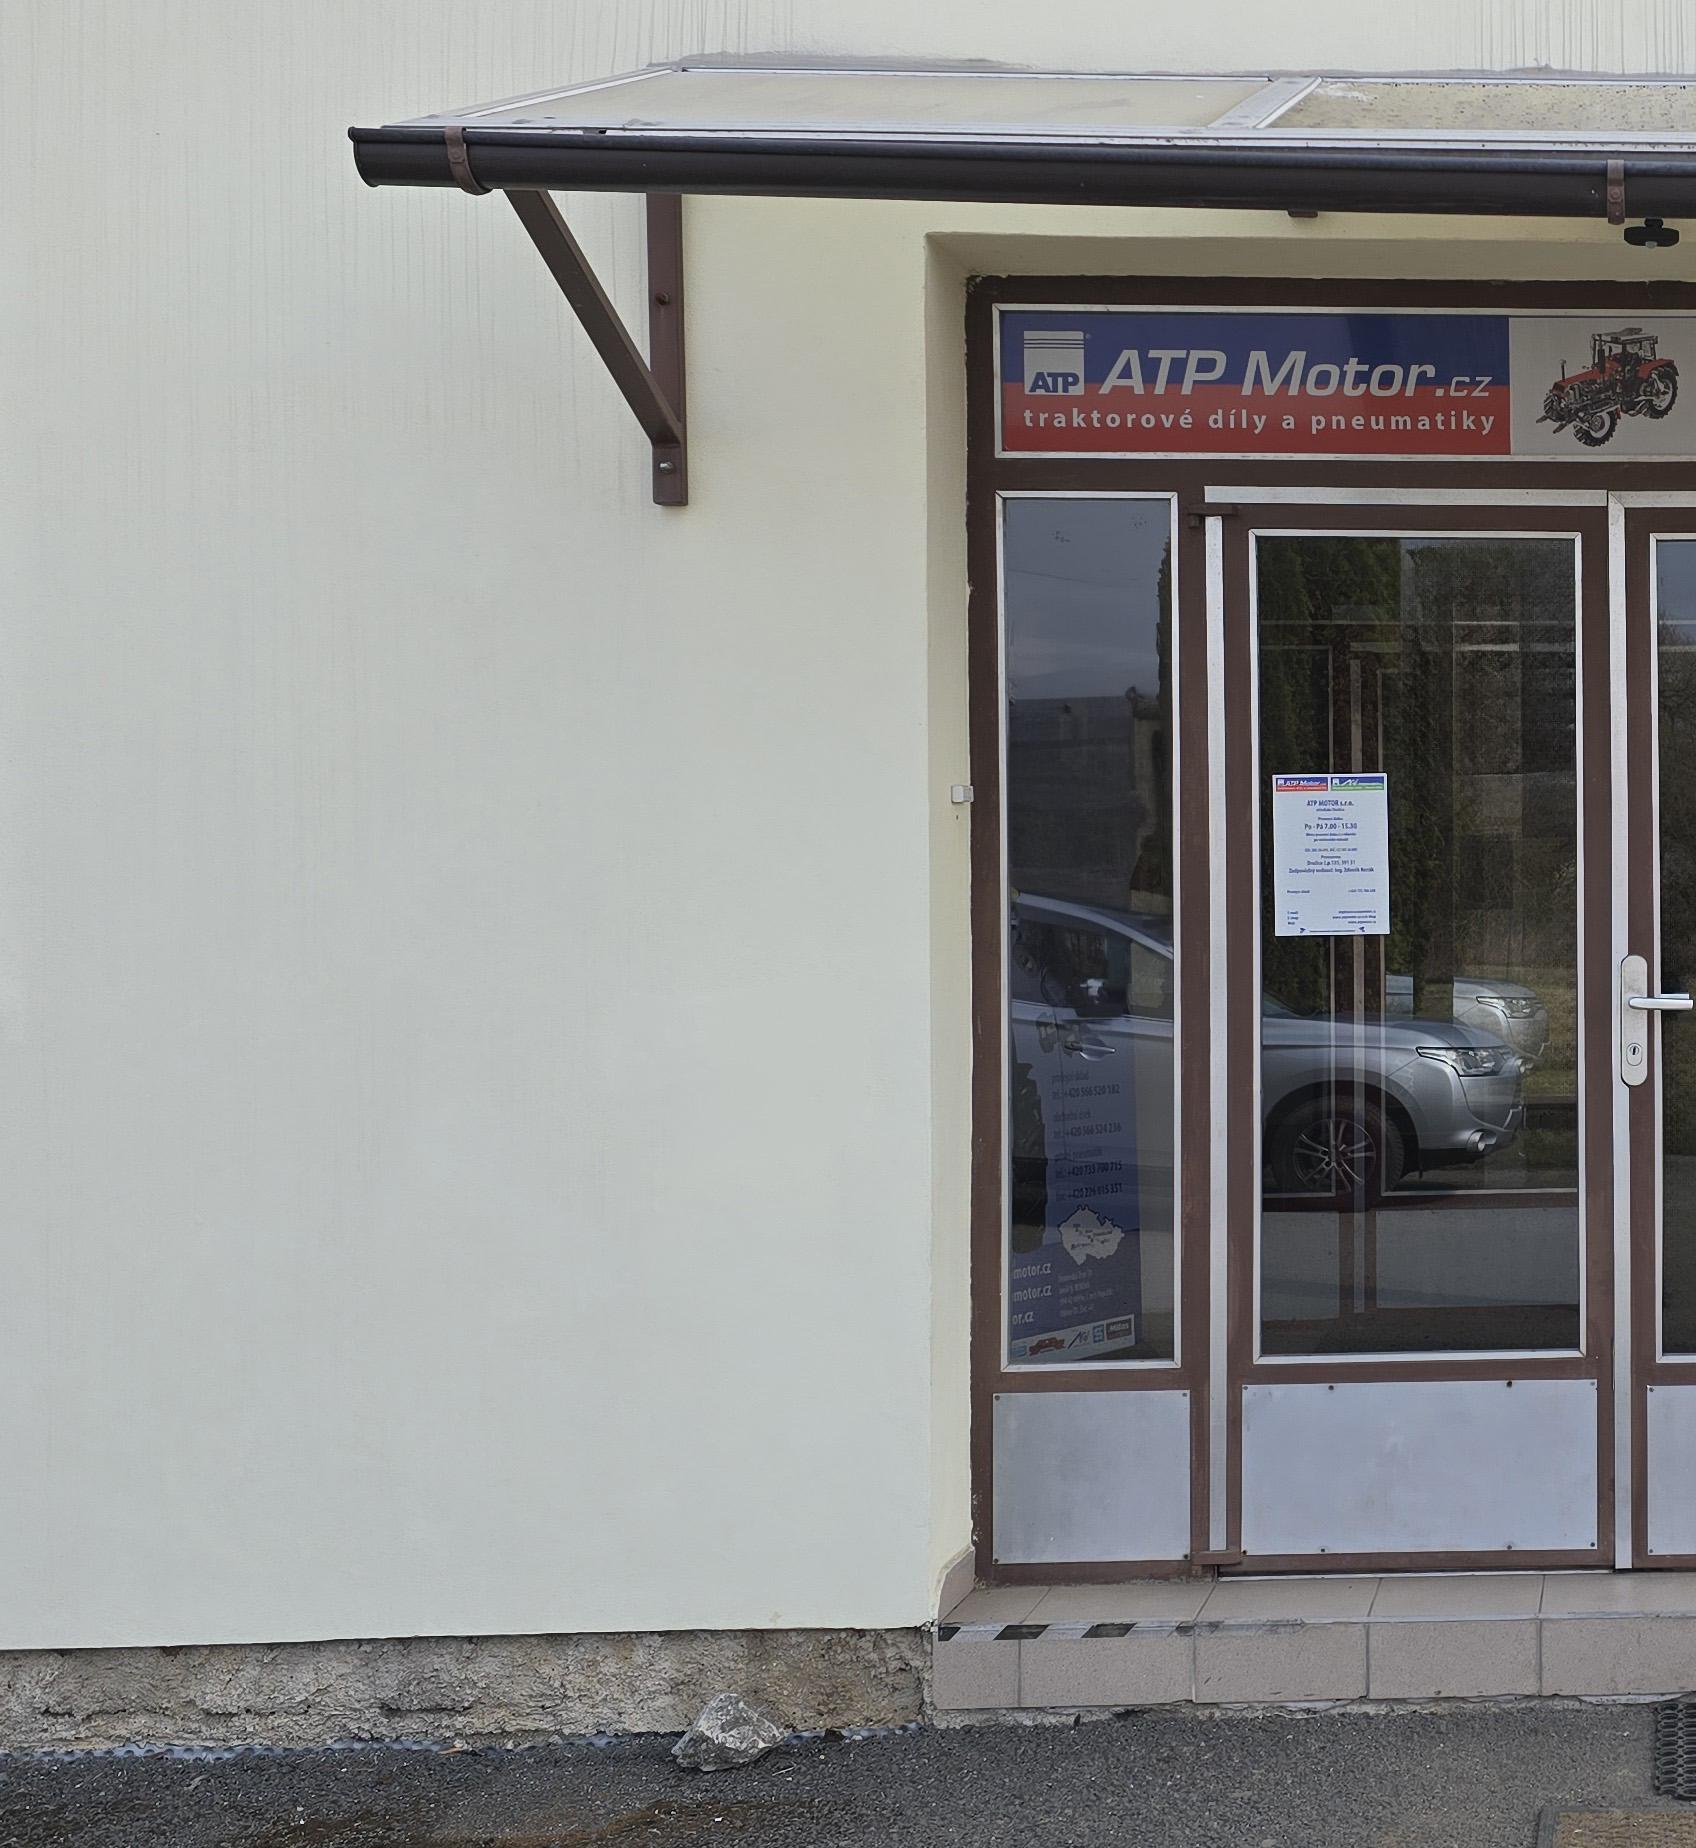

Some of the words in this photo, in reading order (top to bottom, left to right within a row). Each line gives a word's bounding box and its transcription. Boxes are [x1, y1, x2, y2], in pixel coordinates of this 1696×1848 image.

[1029, 371, 1080, 393] ATP
[1098, 349, 1227, 395] ATP
[1240, 350, 1493, 397] Motor.cz
[1023, 407, 1193, 428] traktorové
[1208, 408, 1267, 434] díly
[1282, 415, 1295, 430] a
[1311, 410, 1495, 436] pneumatiky
